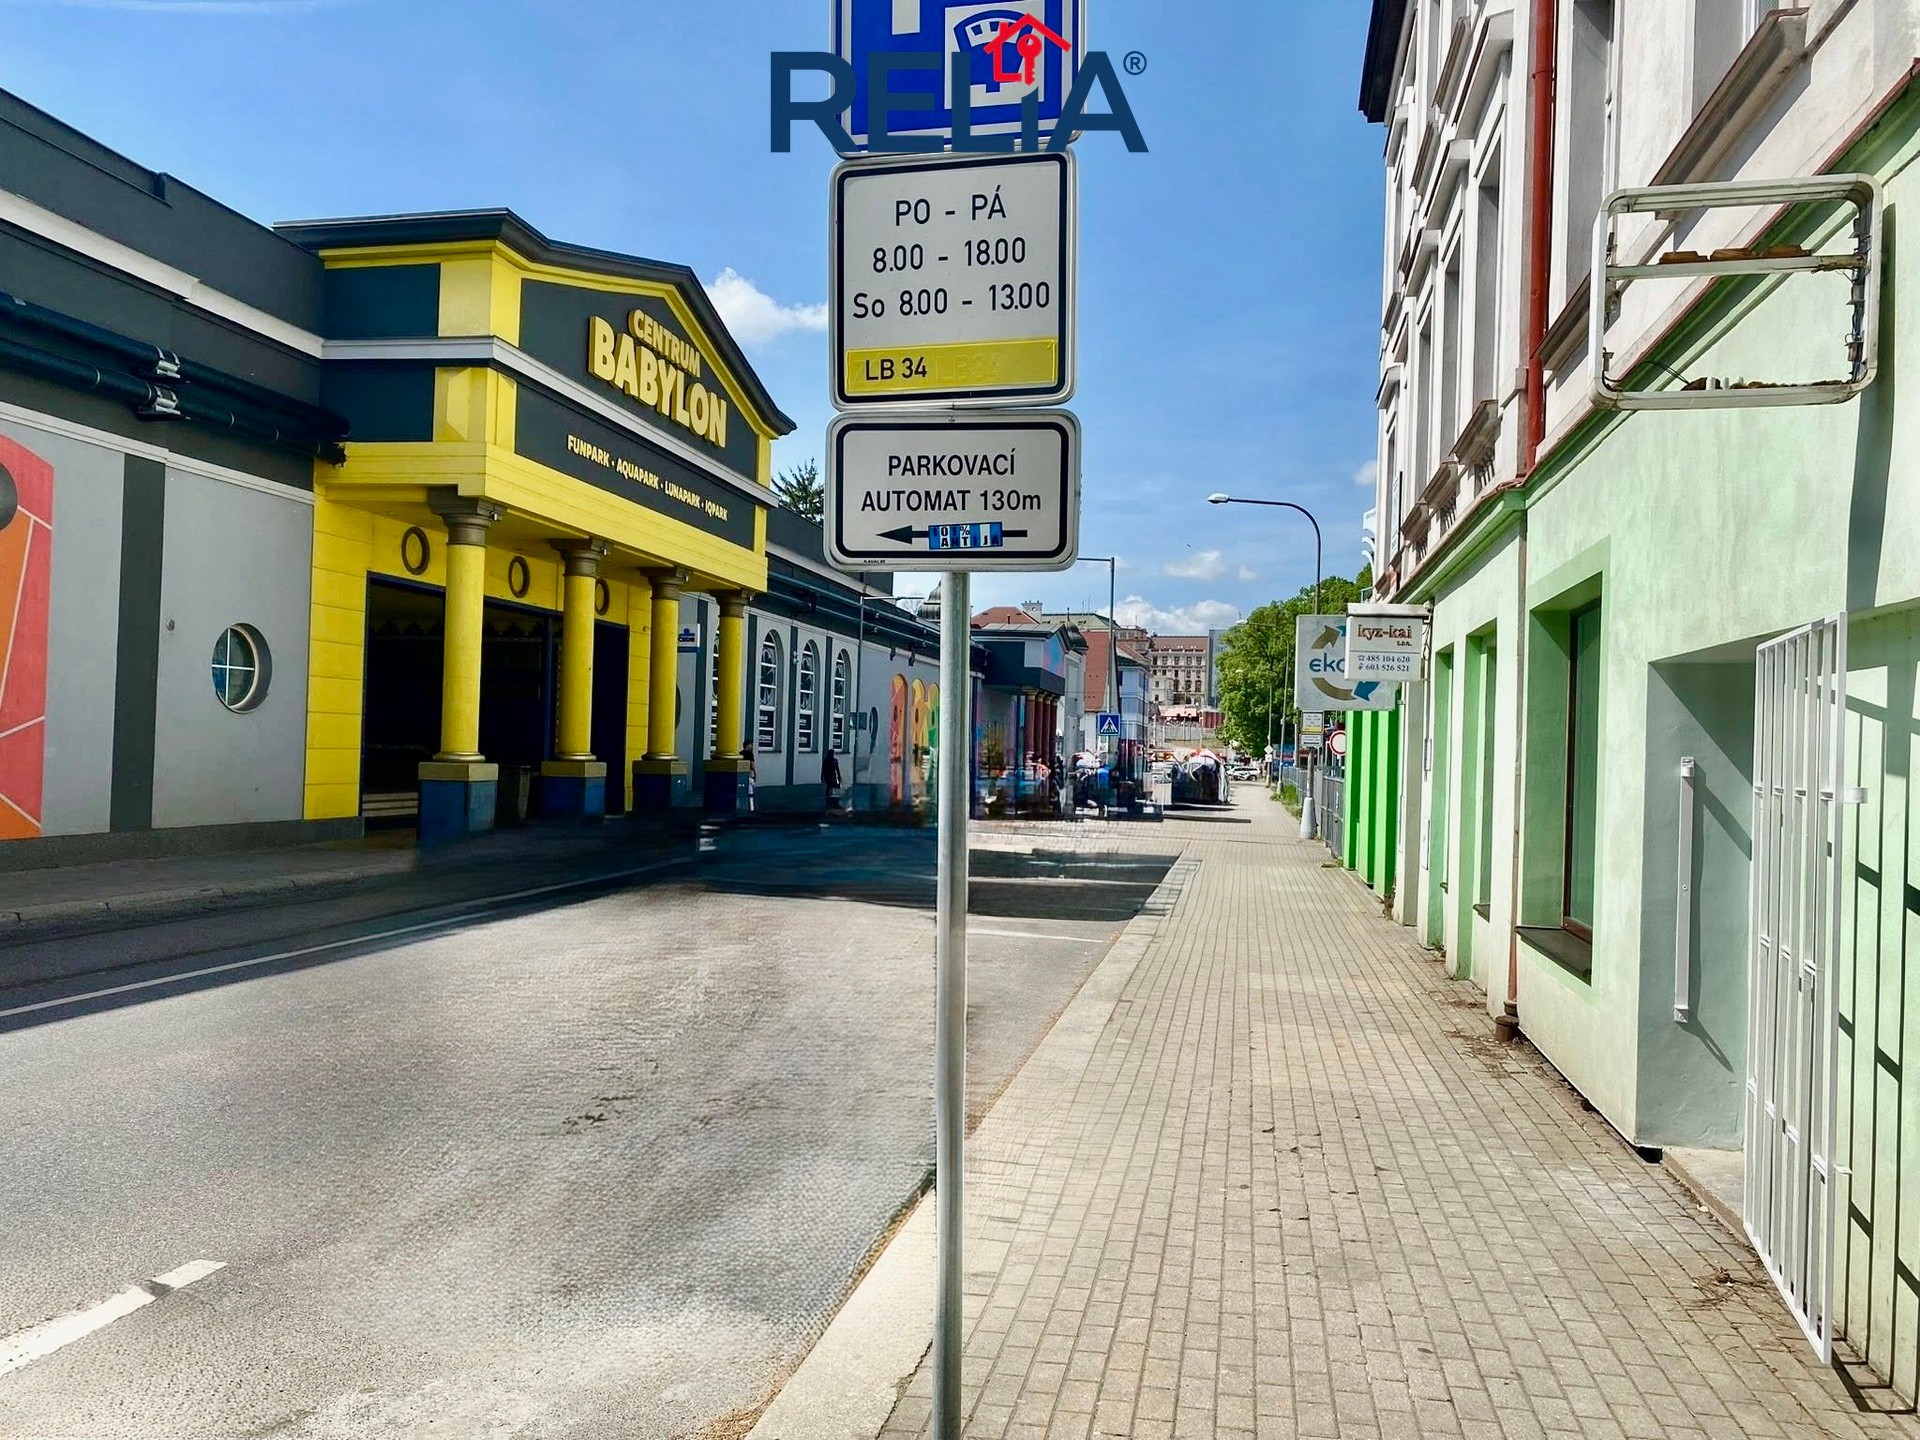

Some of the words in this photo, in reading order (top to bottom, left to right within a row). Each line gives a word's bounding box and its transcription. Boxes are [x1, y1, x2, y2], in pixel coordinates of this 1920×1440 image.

[895, 198, 930, 226] PO
[971, 184, 1006, 222] PÁ
[872, 243, 924, 272] 8.00
[964, 236, 1026, 267] 18.00
[852, 290, 885, 318] So
[899, 288, 948, 316] 8.00
[988, 281, 1050, 311] 13.00
[628, 308, 701, 378] CENTRUM
[588, 314, 728, 449] BABYLON
[865, 358, 895, 381] LB
[901, 356, 928, 380] 34
[567, 434, 610, 468] FUNPARK
[616, 458, 659, 491] AQUAPARK
[664, 480, 701, 510] LUNAPARK
[705, 499, 728, 522] IQPARK
[888, 448, 1016, 476] PARKOVACÍ
[861, 489, 971, 513] AUTOMAT
[979, 488, 1042, 512] 130m
